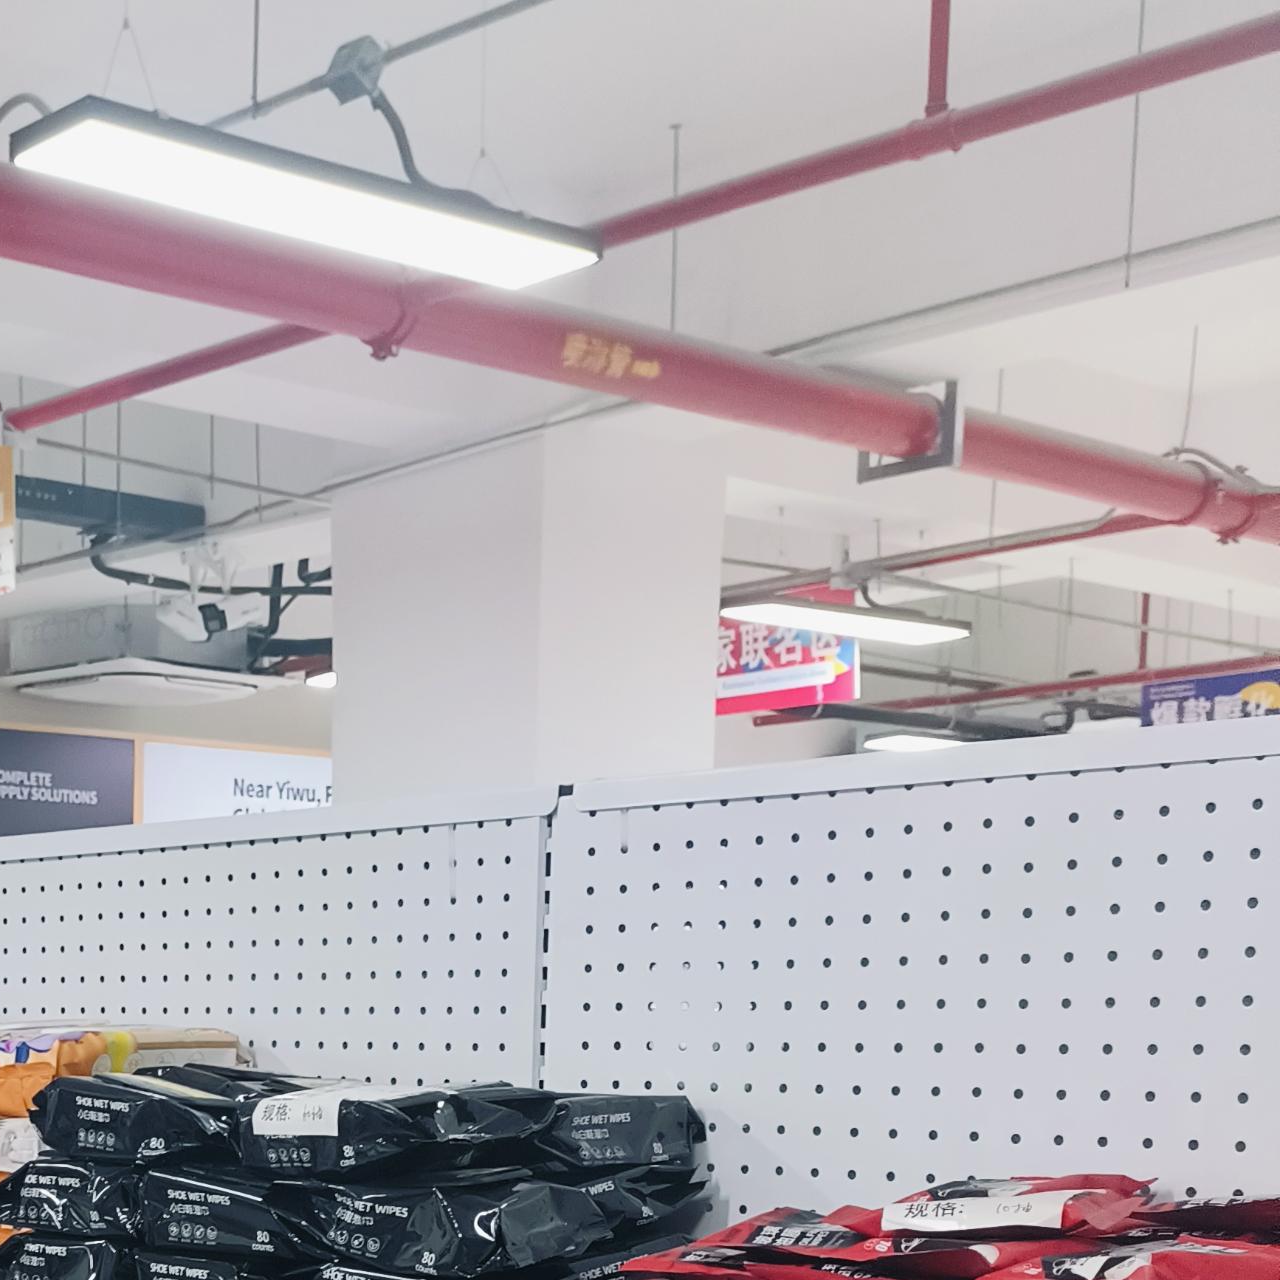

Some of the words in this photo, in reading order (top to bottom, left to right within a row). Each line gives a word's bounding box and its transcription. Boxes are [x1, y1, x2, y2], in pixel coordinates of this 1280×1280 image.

[30, 787, 98, 805] SOLUTIONS
[233, 778, 272, 799] Near
[276, 780, 321, 807] Yiwu,
[76, 1096, 93, 1108] SHOE
[94, 1098, 109, 1109] WET
[110, 1100, 130, 1112] WIPES
[591, 1114, 609, 1124] WET
[609, 1112, 631, 1123] WIPES
[149, 1137, 165, 1149] 80
[39, 1175, 57, 1185] WET
[58, 1177, 81, 1188] WIPES
[588, 1180, 615, 1195] WIPES
[167, 1189, 187, 1200] SHOE
[188, 1192, 205, 1202] WET
[206, 1194, 231, 1206] WIPES
[374, 1203, 409, 1218] WIPES
[256, 1230, 270, 1243] 80
[45, 1246, 67, 1257] WIPES
[421, 1251, 436, 1266] 80
[150, 1262, 168, 1274] SHOE
[168, 1265, 186, 1276] WET
[186, 1268, 210, 1280] WIPES
[415, 1264, 438, 1275] counts
[580, 1267, 602, 1280] SHOE
[603, 1262, 622, 1275] WET
